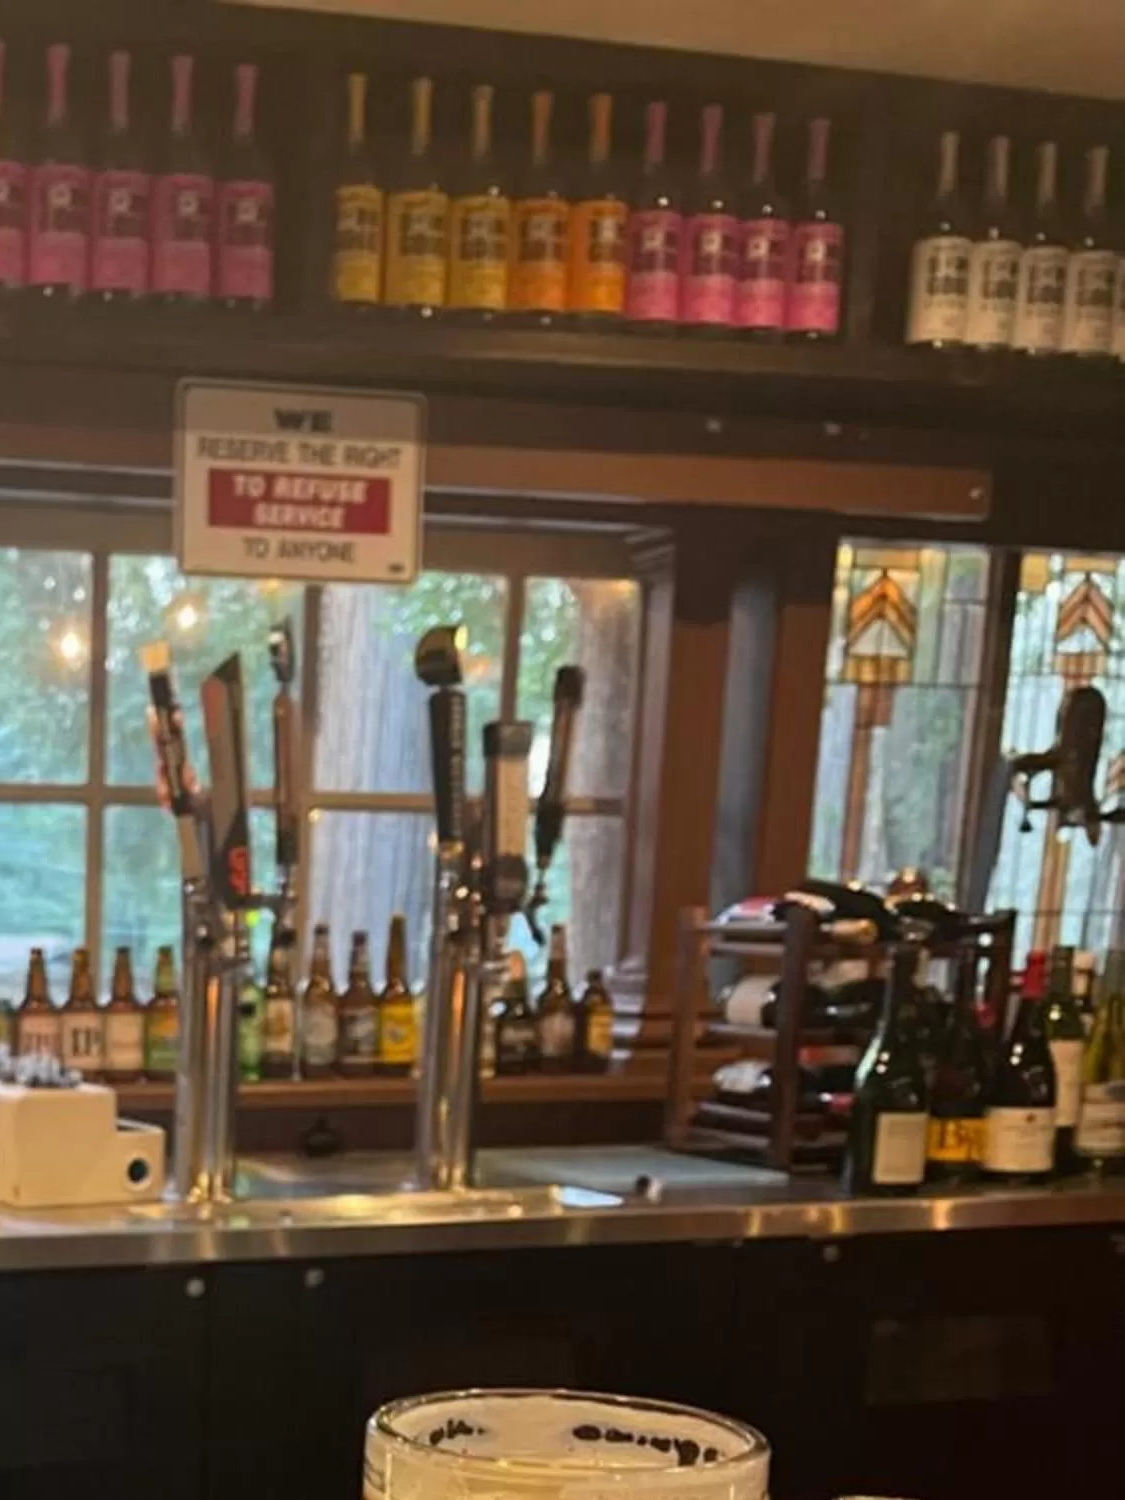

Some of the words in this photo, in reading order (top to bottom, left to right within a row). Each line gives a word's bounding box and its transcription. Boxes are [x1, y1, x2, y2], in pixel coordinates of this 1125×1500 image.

[273, 408, 333, 433] WE
[197, 436, 288, 462] RESERVE
[298, 442, 336, 465] THE
[342, 445, 402, 468] RIGHT
[232, 473, 266, 497] TO
[274, 476, 369, 504] REFUSE
[253, 502, 347, 529] SERVICE
[242, 536, 269, 557] TO
[277, 539, 355, 563] ANYONE
